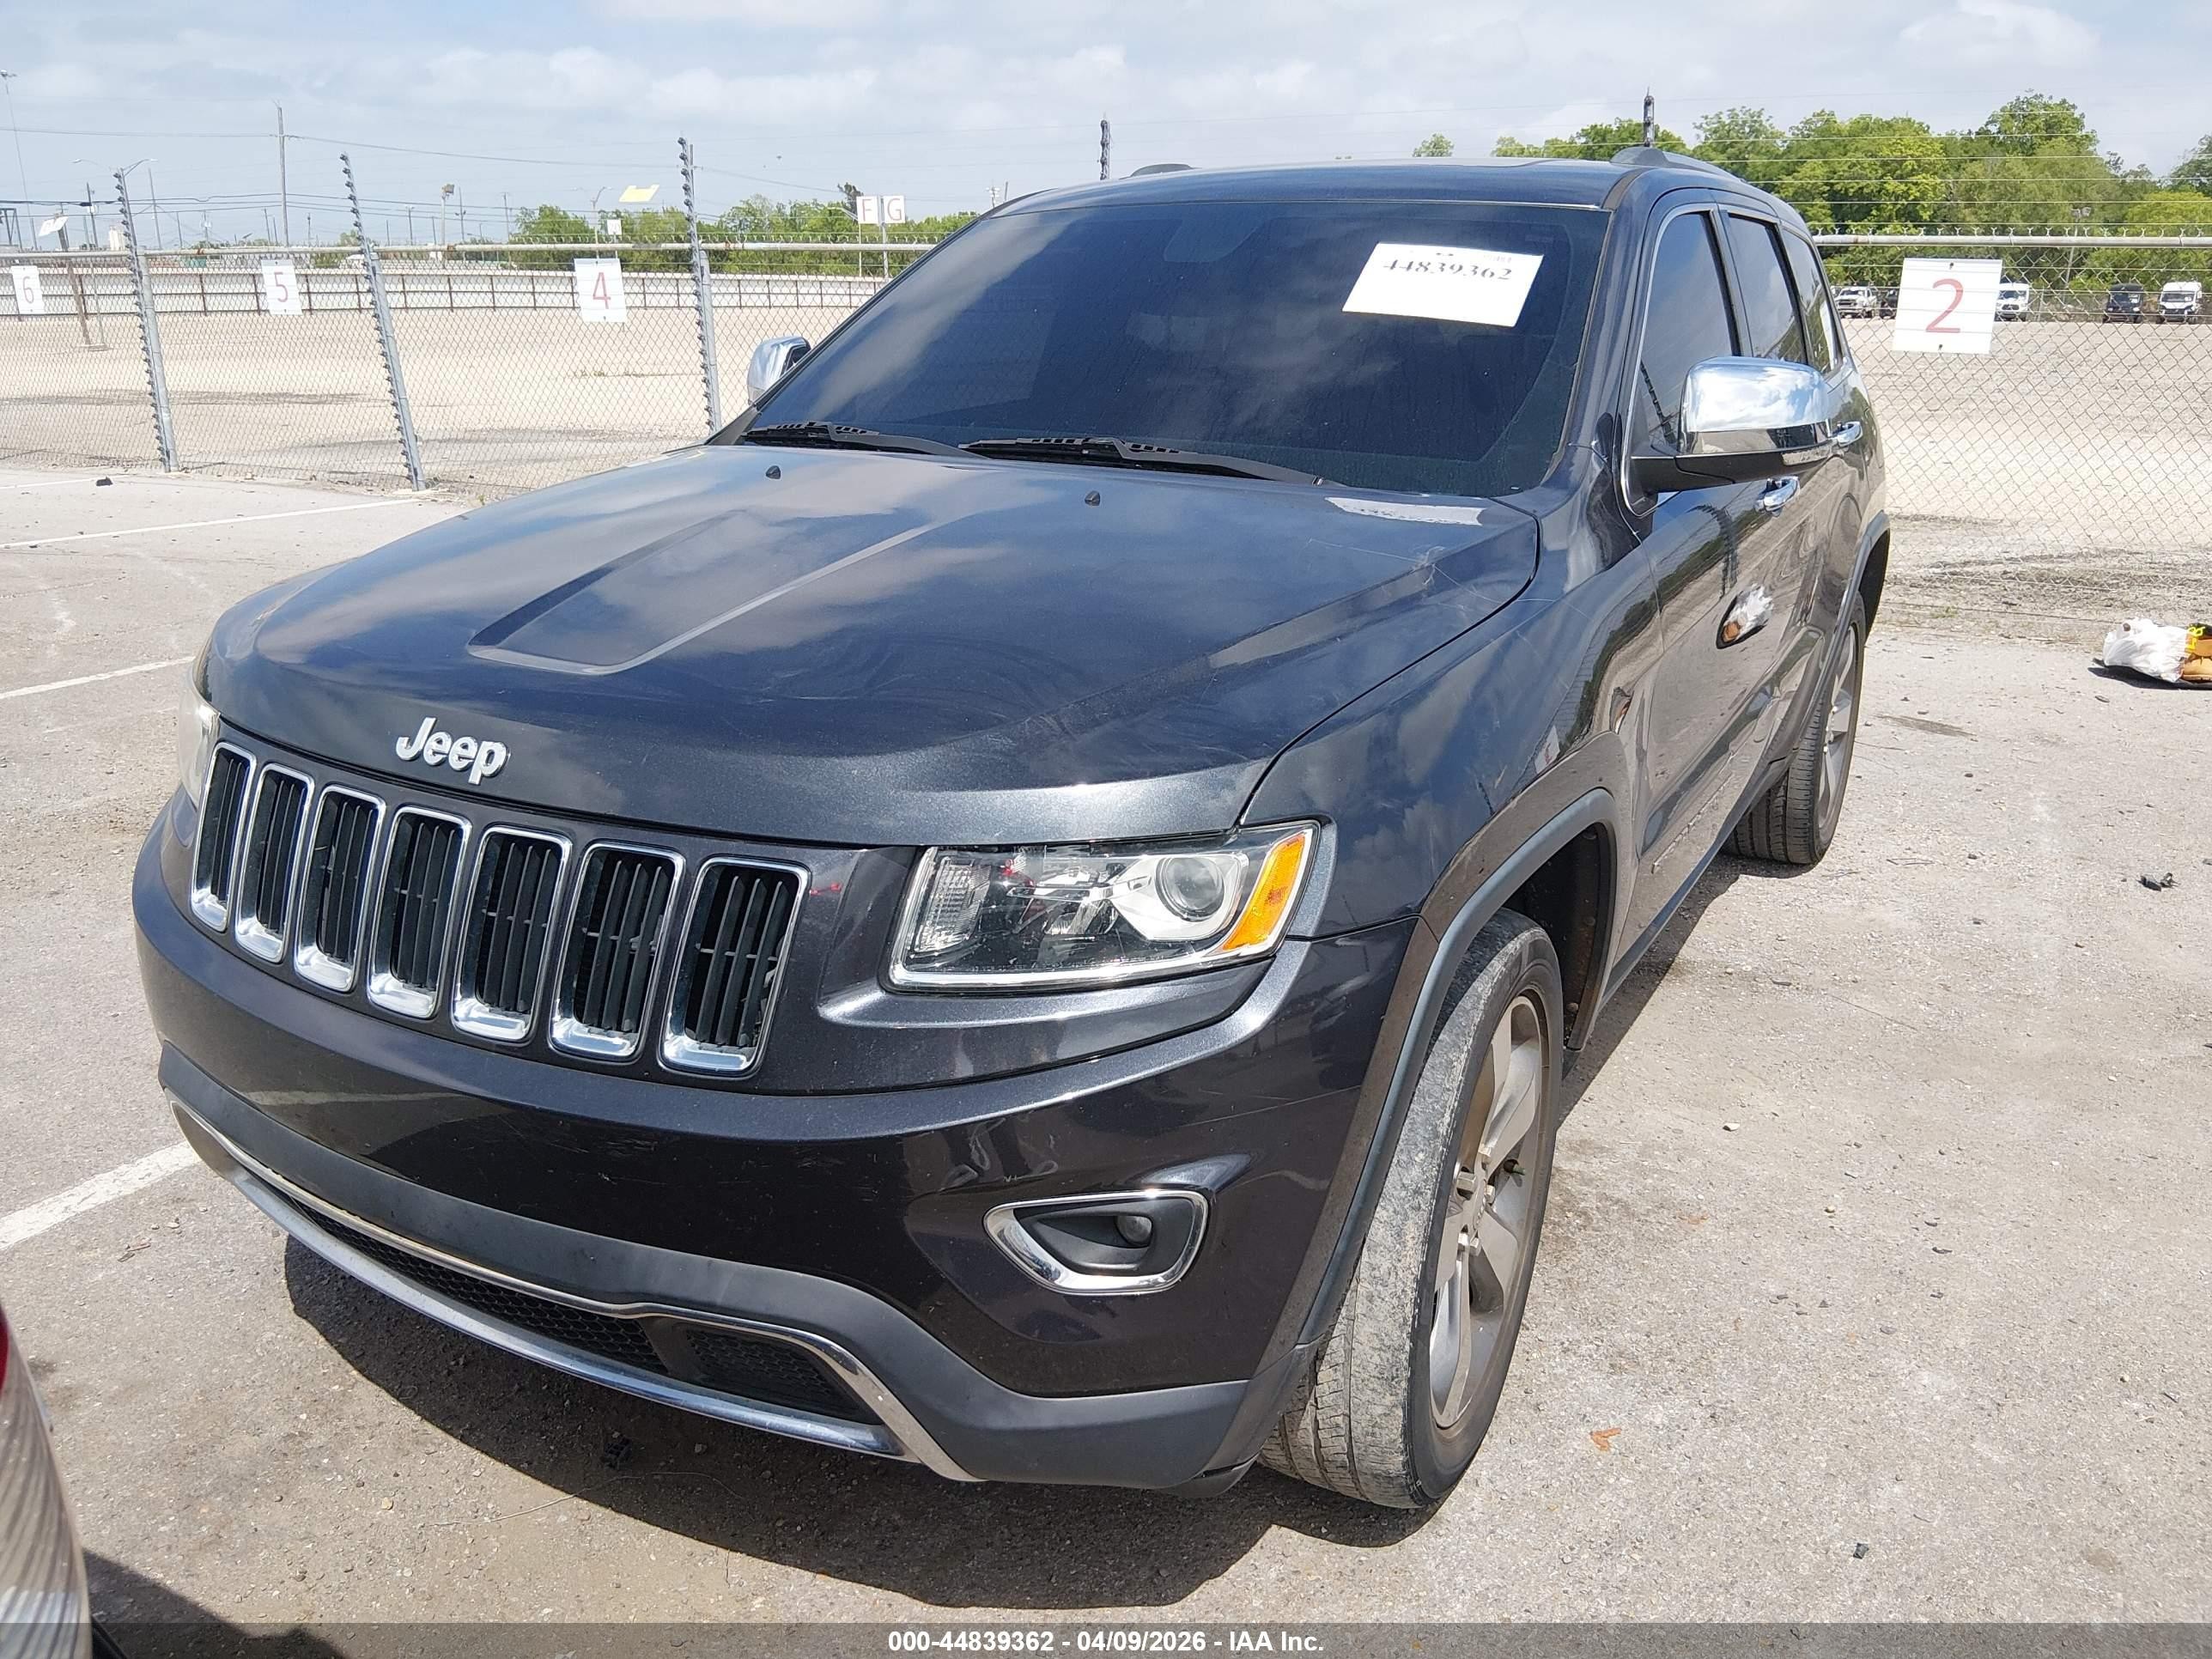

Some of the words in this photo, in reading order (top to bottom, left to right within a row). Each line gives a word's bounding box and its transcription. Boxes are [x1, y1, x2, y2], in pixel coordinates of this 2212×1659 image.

[861, 198, 872, 222] F
[887, 198, 902, 221] G
[1383, 259, 1511, 280] 44839362
[23, 276, 34, 304] 6
[274, 272, 289, 302] 5
[592, 272, 611, 309] 4
[1926, 279, 1963, 333] 2
[396, 716, 511, 786] Jeep
